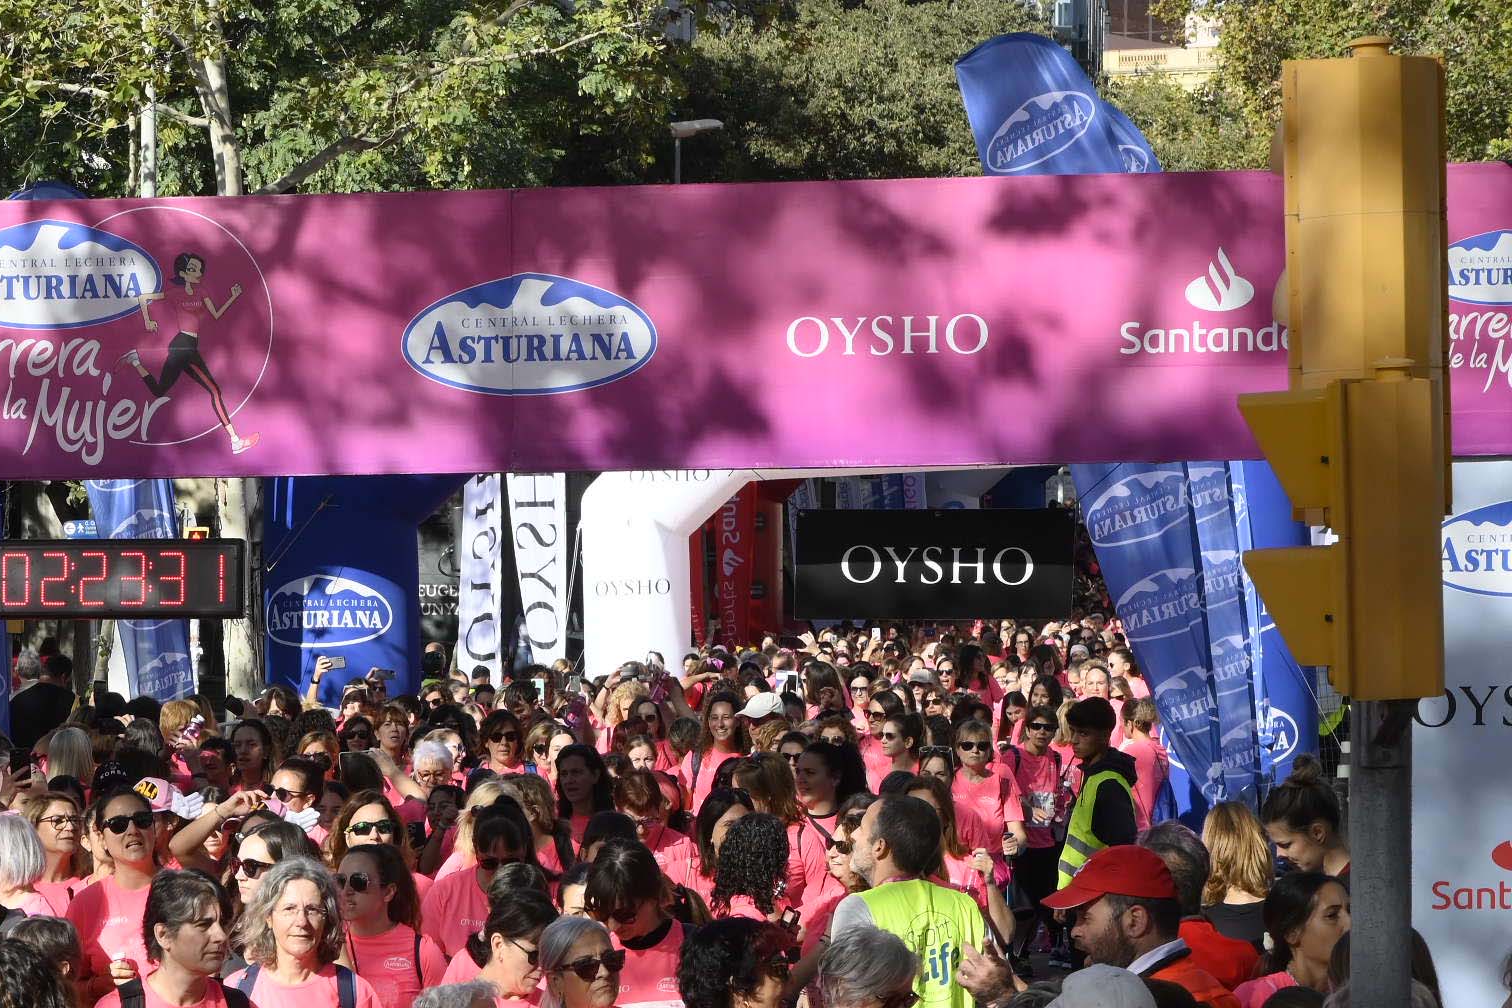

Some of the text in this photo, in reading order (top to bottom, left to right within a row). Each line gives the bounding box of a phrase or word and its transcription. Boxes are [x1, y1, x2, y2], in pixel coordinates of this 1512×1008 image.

[65, 255, 137, 267] LECHERA
[461, 313, 630, 329] CENTRAL LECHERA
[787, 313, 989, 357] OYSHO
[422, 319, 638, 366] ASTURIANA
[2, 383, 28, 421] la
[21, 374, 171, 466] Mujer
[841, 545, 1034, 586] OYSHO
[595, 578, 671, 596] OYSHO
[270, 602, 383, 631] ASTURIANA
[329, 599, 379, 607] LECHERA
[1431, 880, 1512, 910] Sant
